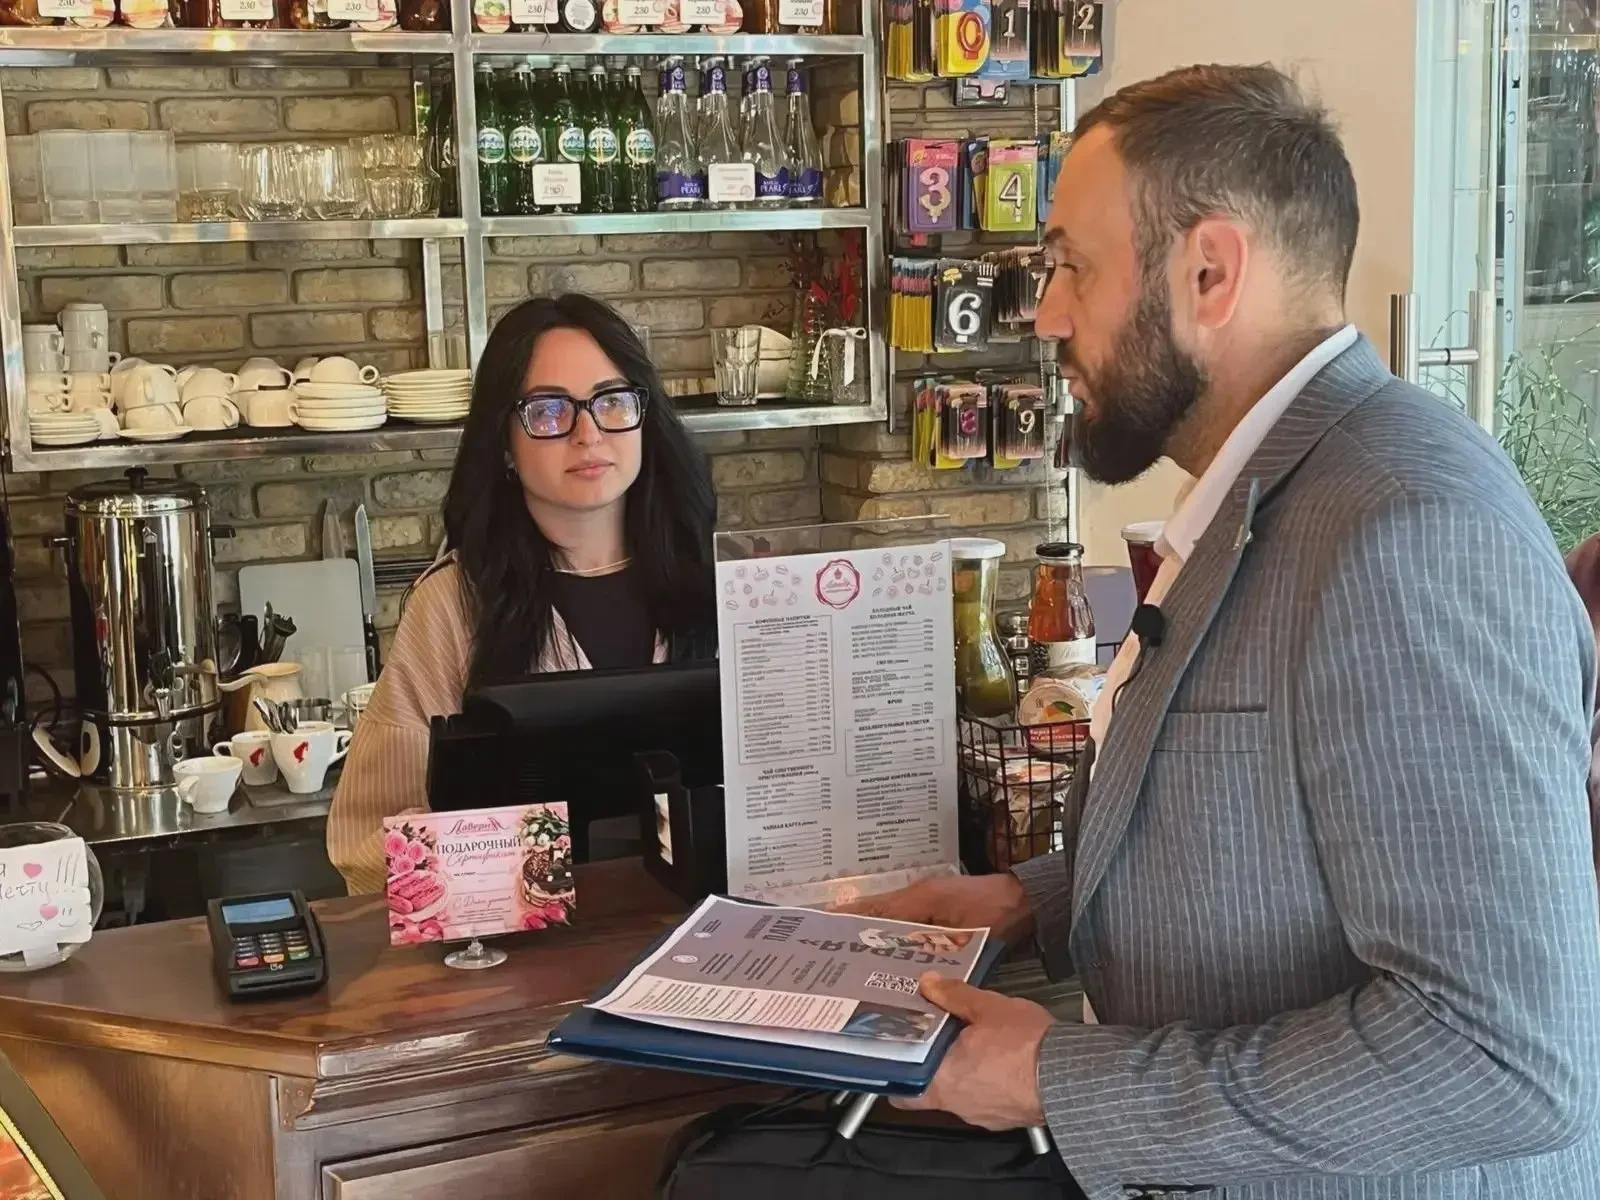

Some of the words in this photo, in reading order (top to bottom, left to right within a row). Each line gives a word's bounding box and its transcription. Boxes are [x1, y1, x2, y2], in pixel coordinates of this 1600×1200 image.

[240, 1, 255, 9] 230
[345, 2, 361, 10] 230
[528, 4, 542, 13] 230
[634, 6, 649, 14] 230
[696, 6, 711, 15] 230
[794, 8, 808, 16] 230
[1003, 10, 1015, 38] 1
[1078, 4, 1094, 30] 2
[957, 11, 984, 50] 0
[918, 166, 950, 210] 3
[999, 172, 1026, 208] 4
[949, 292, 982, 336] 6
[1019, 410, 1036, 434] 9
[436, 836, 522, 854] ПОДАРОЧНЫЙ
